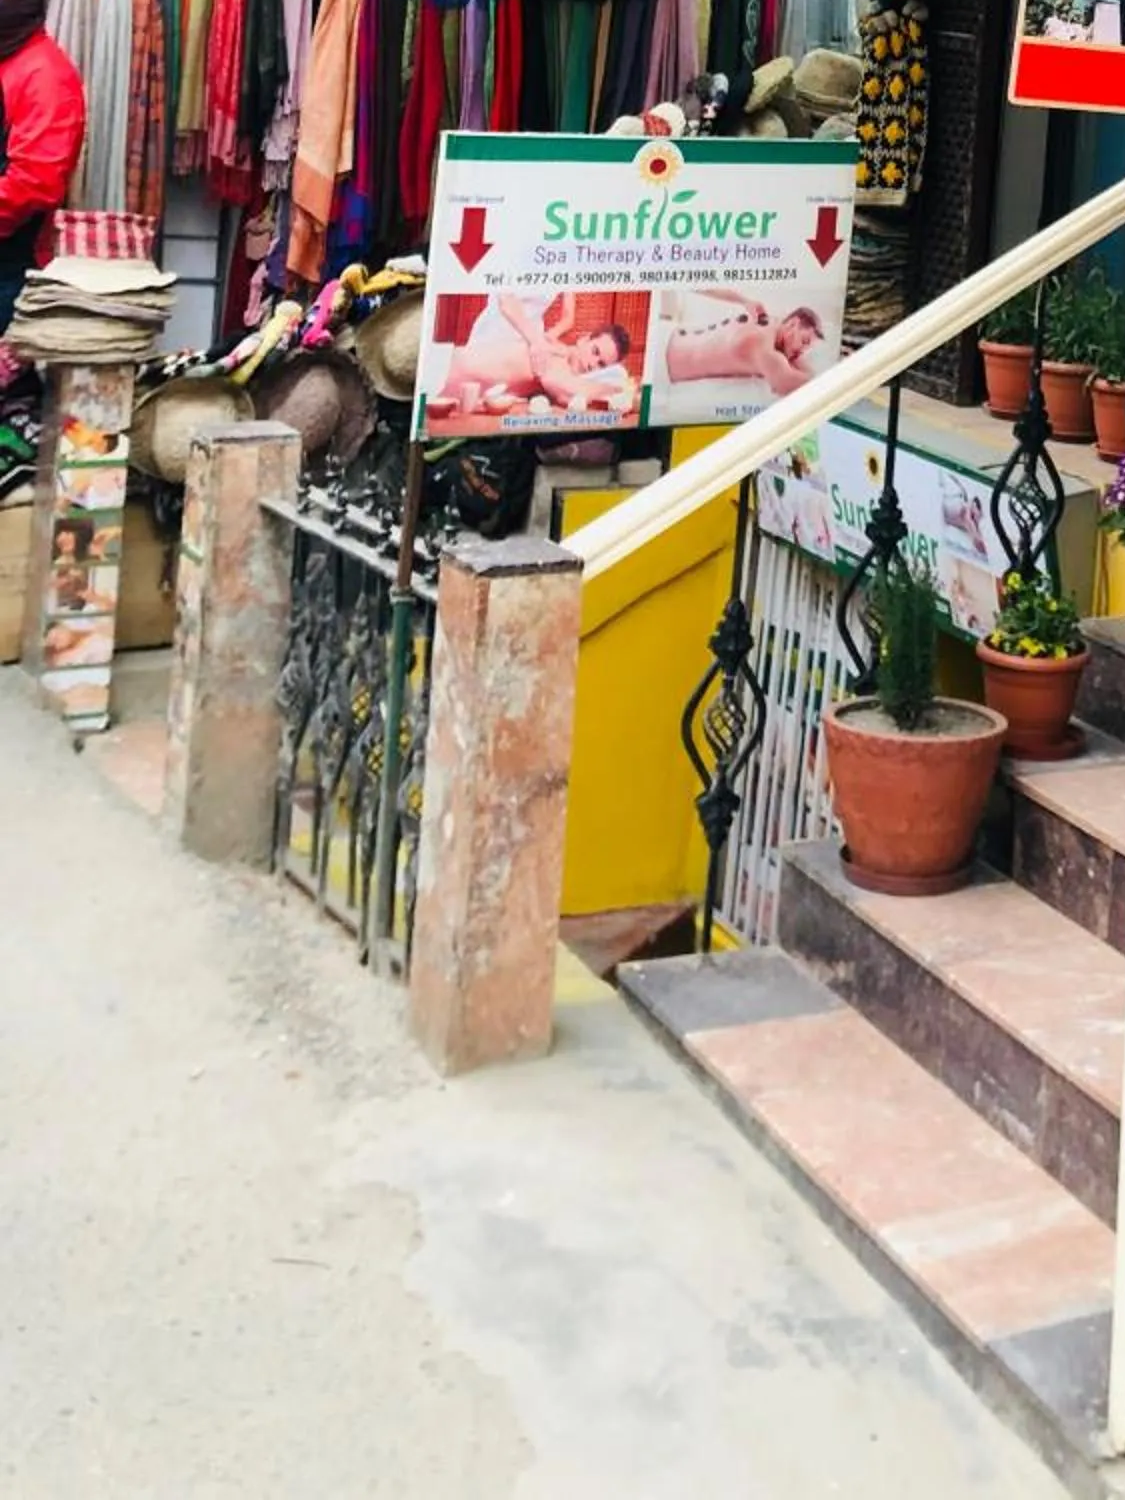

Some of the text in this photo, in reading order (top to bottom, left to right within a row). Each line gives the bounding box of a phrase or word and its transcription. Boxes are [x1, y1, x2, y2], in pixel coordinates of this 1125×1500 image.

[543, 190, 778, 241] Sunflower
[533, 243, 781, 265] Spa Therapy & Beauty Home
